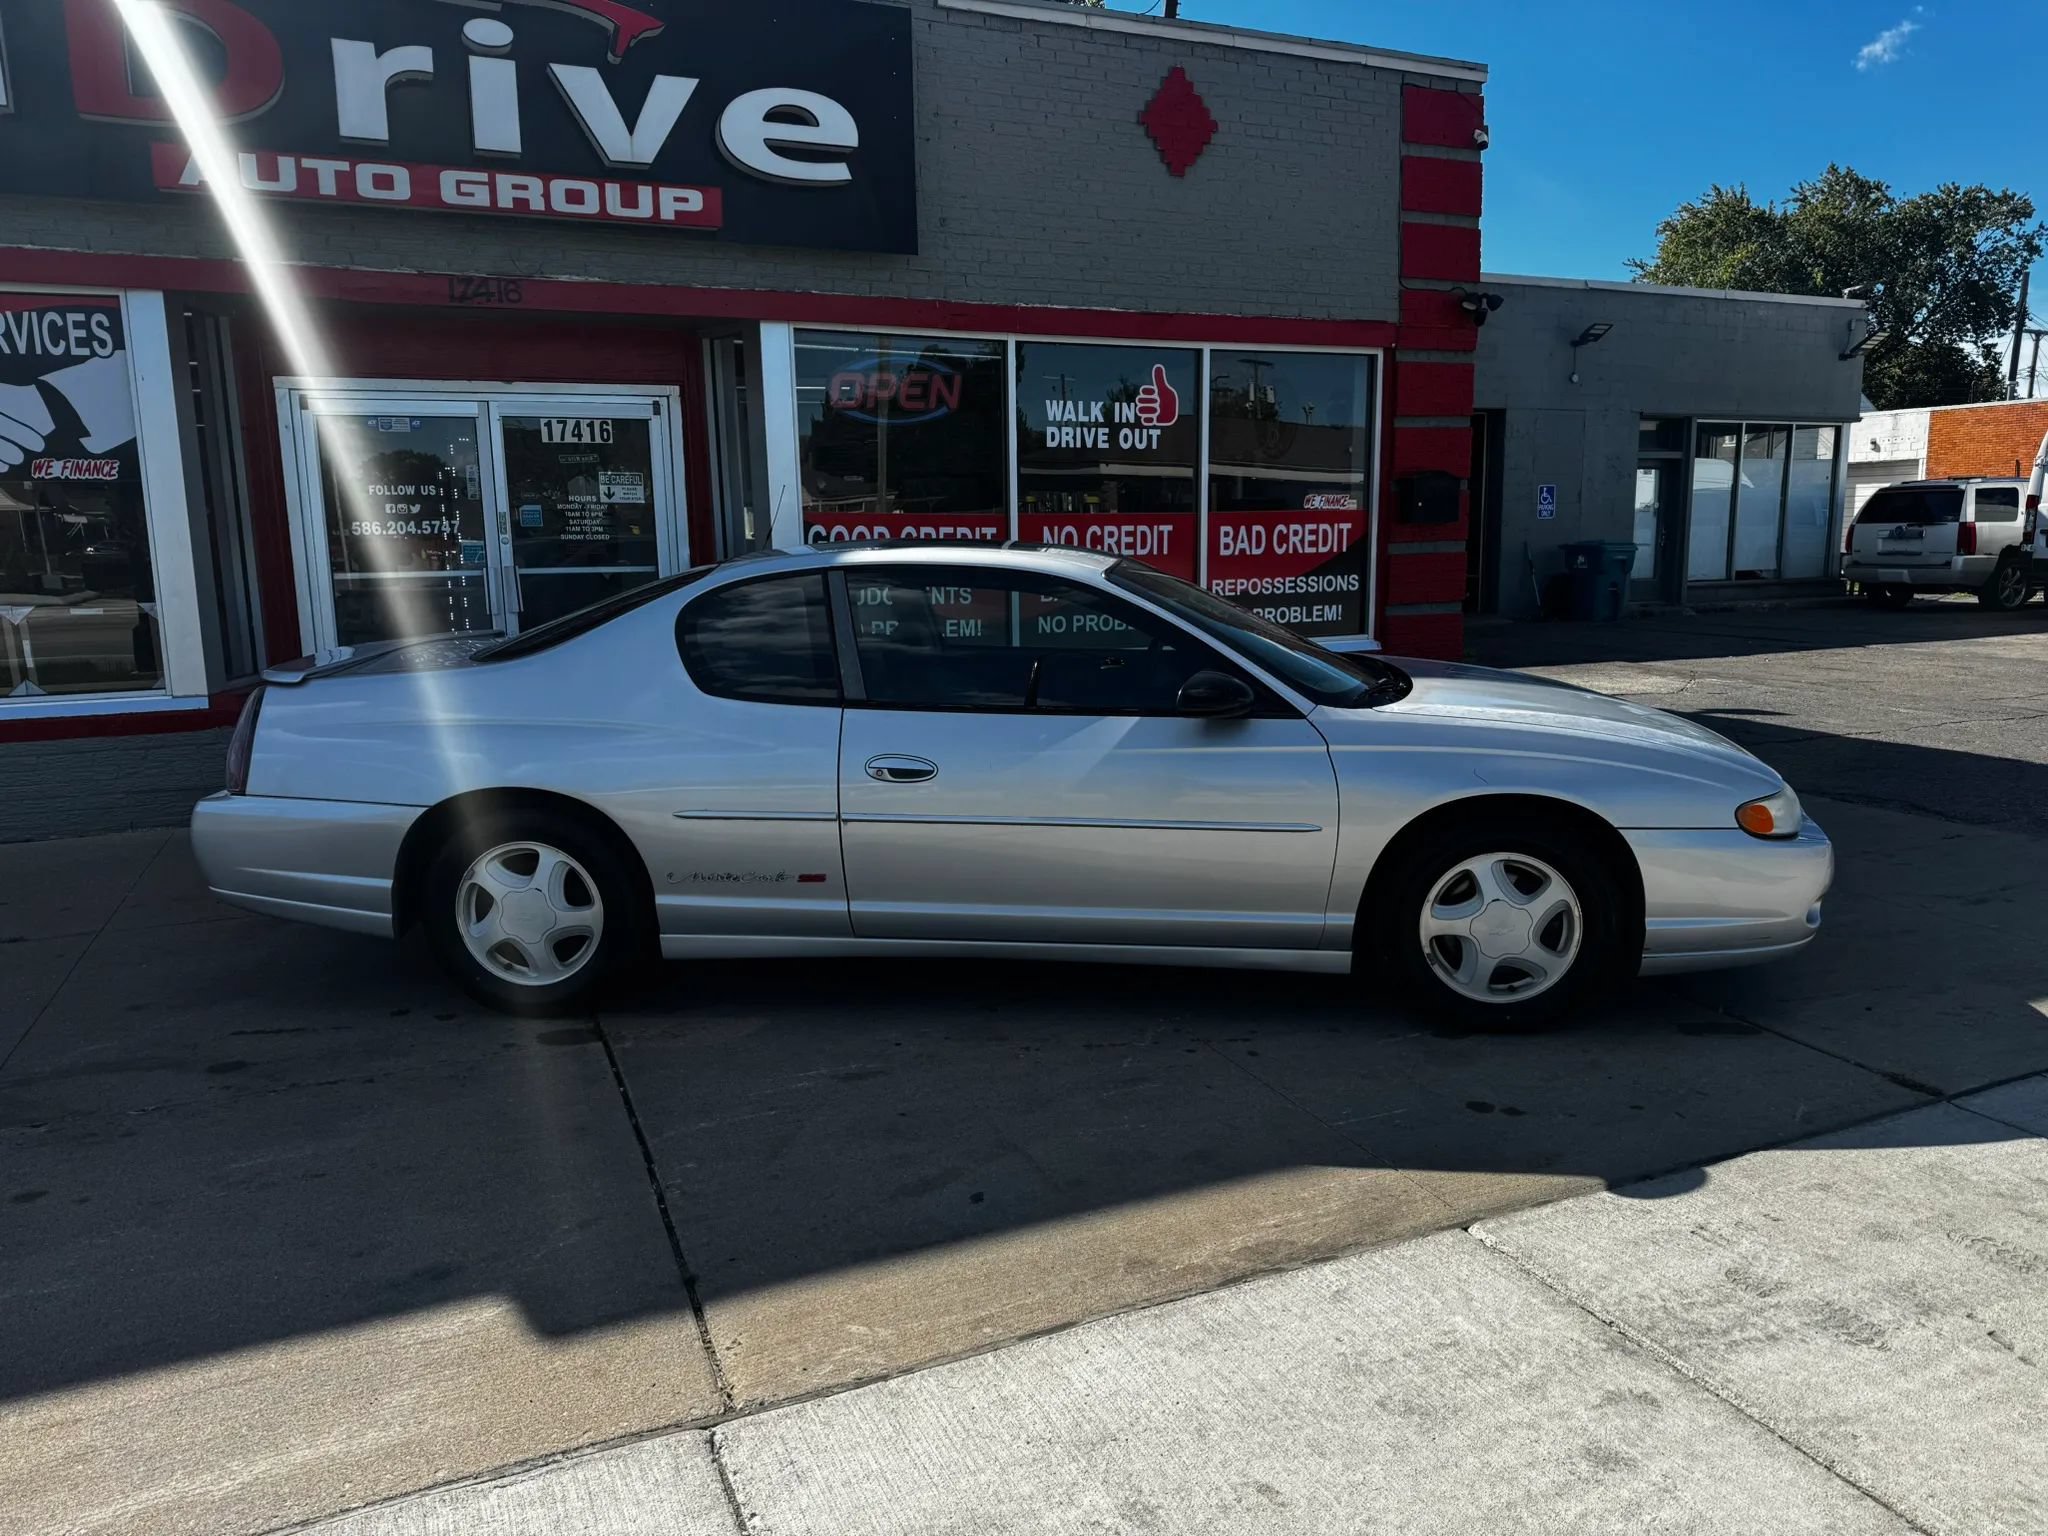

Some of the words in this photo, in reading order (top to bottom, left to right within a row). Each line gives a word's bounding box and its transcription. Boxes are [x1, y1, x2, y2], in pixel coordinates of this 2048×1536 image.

[68, 0, 860, 185] Drive
[179, 153, 410, 201] AUTO
[440, 169, 705, 222] GROUP
[829, 371, 963, 412] OPEN
[1045, 399, 1105, 422] WALK
[1114, 401, 1136, 423] IN
[543, 419, 611, 443] 17416
[1046, 426, 1110, 449] DRIVE
[1118, 428, 1161, 450] OUT
[32, 458, 55, 478] WE
[60, 459, 119, 480] FINANCE
[611, 475, 642, 485] CAREFUL
[368, 485, 415, 496] FOLLOW
[421, 485, 436, 496] US
[351, 520, 460, 535] 586.204.5747
[1219, 524, 1267, 557] BAD
[1272, 522, 1353, 556] CREDIT
[1086, 524, 1173, 556] CREDIT
[1211, 574, 1360, 597] REPOSSESSIONS
[1038, 615, 1067, 634] NO
